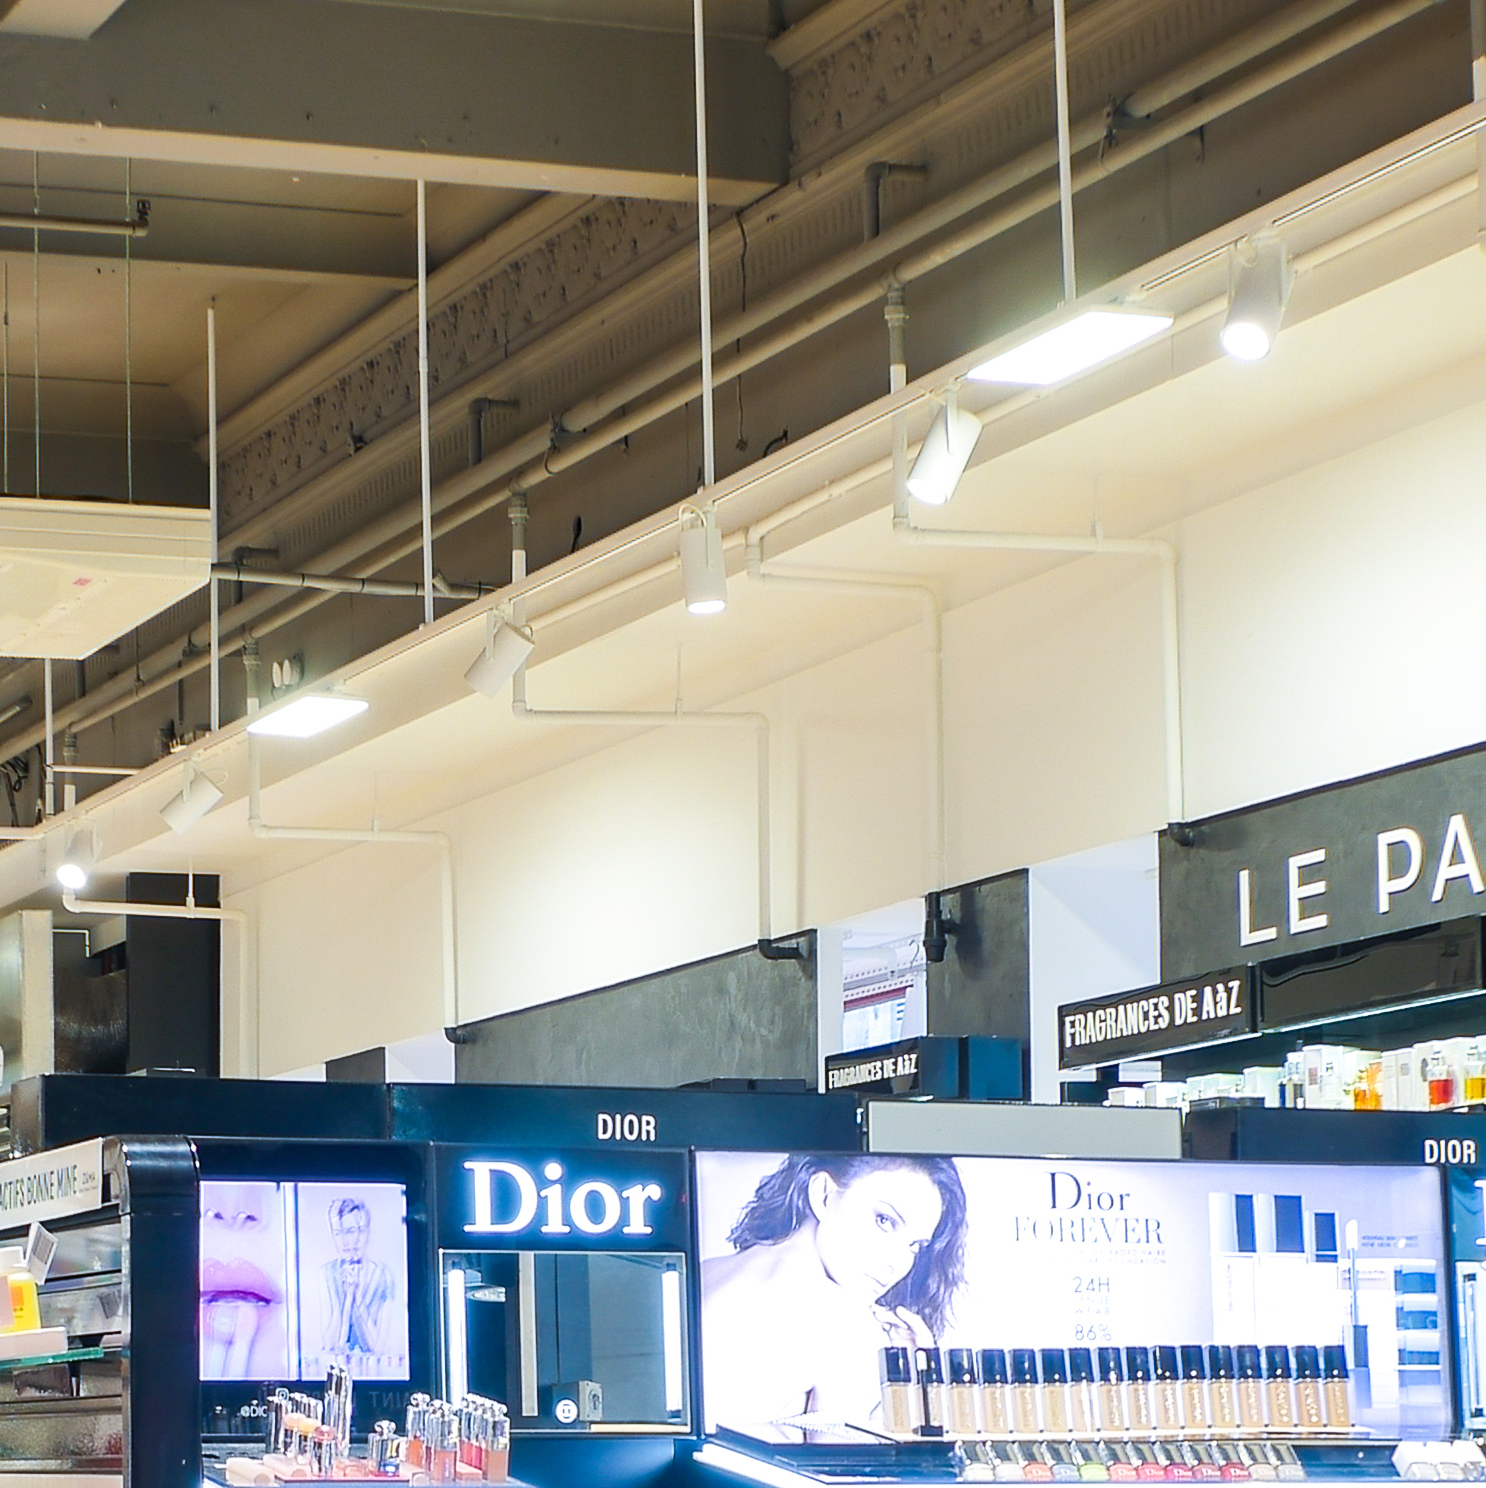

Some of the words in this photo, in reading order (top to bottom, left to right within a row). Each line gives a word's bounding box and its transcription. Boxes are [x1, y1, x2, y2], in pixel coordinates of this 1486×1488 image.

[1238, 847, 1328, 947] LE
[1064, 995, 1170, 1048] FRAGRANCES
[1173, 989, 1198, 1026] DE
[828, 1061, 882, 1089] FRAGRANCES
[596, 1112, 656, 1142] DIOR
[1424, 1139, 1477, 1164] DIOR
[27, 1170, 54, 1206] BONNE
[57, 1164, 78, 1199] MINE
[461, 1159, 662, 1235] Dior
[1044, 1171, 1131, 1211] Dior
[1013, 1216, 1164, 1244] FOREVER
[1073, 1276, 1110, 1293] 24H
[1075, 1323, 1112, 1341] 86%
